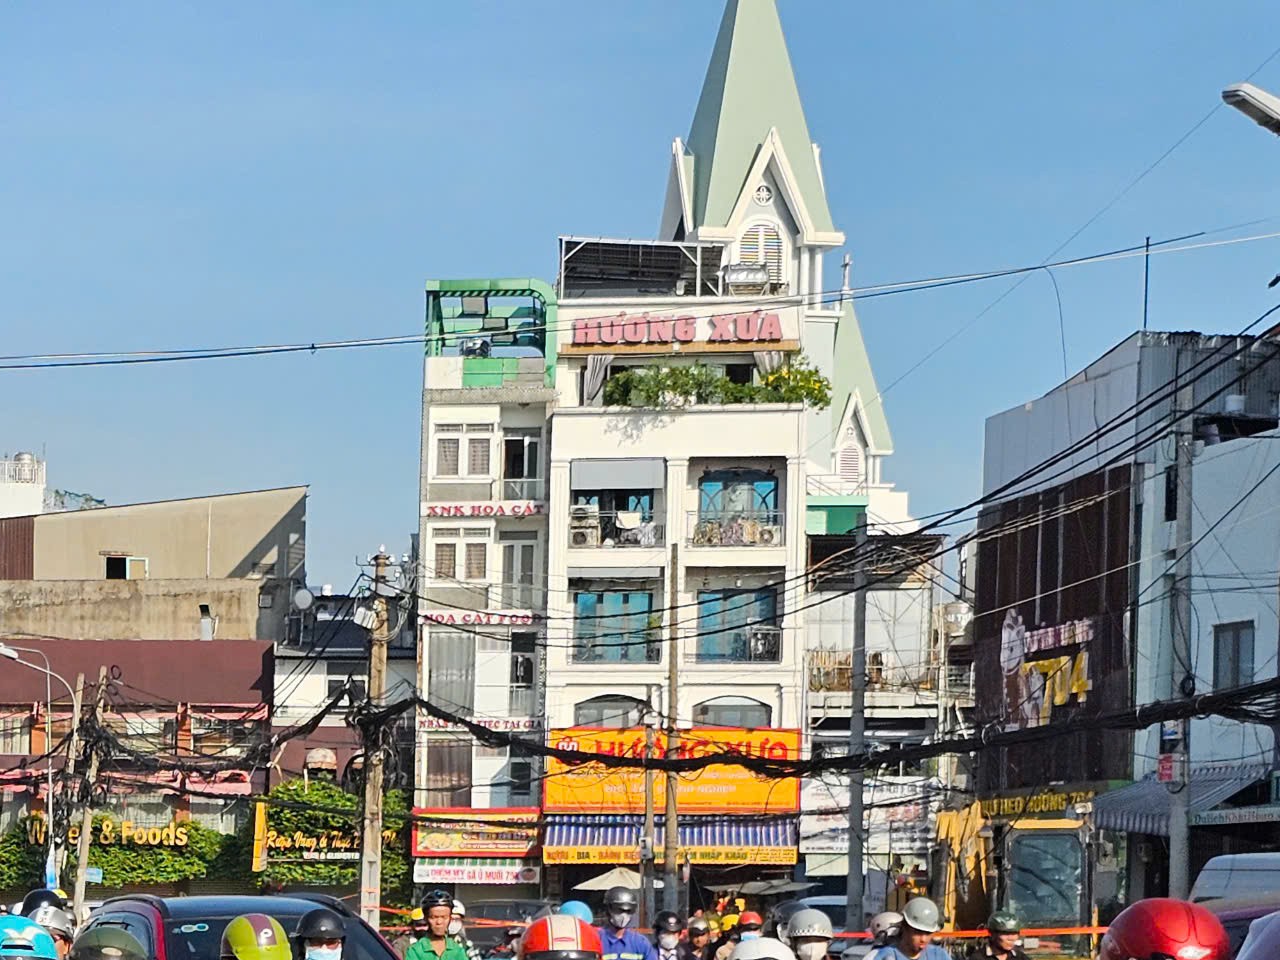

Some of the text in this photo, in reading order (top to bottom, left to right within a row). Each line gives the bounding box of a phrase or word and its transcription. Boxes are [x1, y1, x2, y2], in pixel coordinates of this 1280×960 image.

[426, 505, 465, 517] XNK
[470, 505, 506, 517] HOA
[121, 821, 189, 846] Foods
